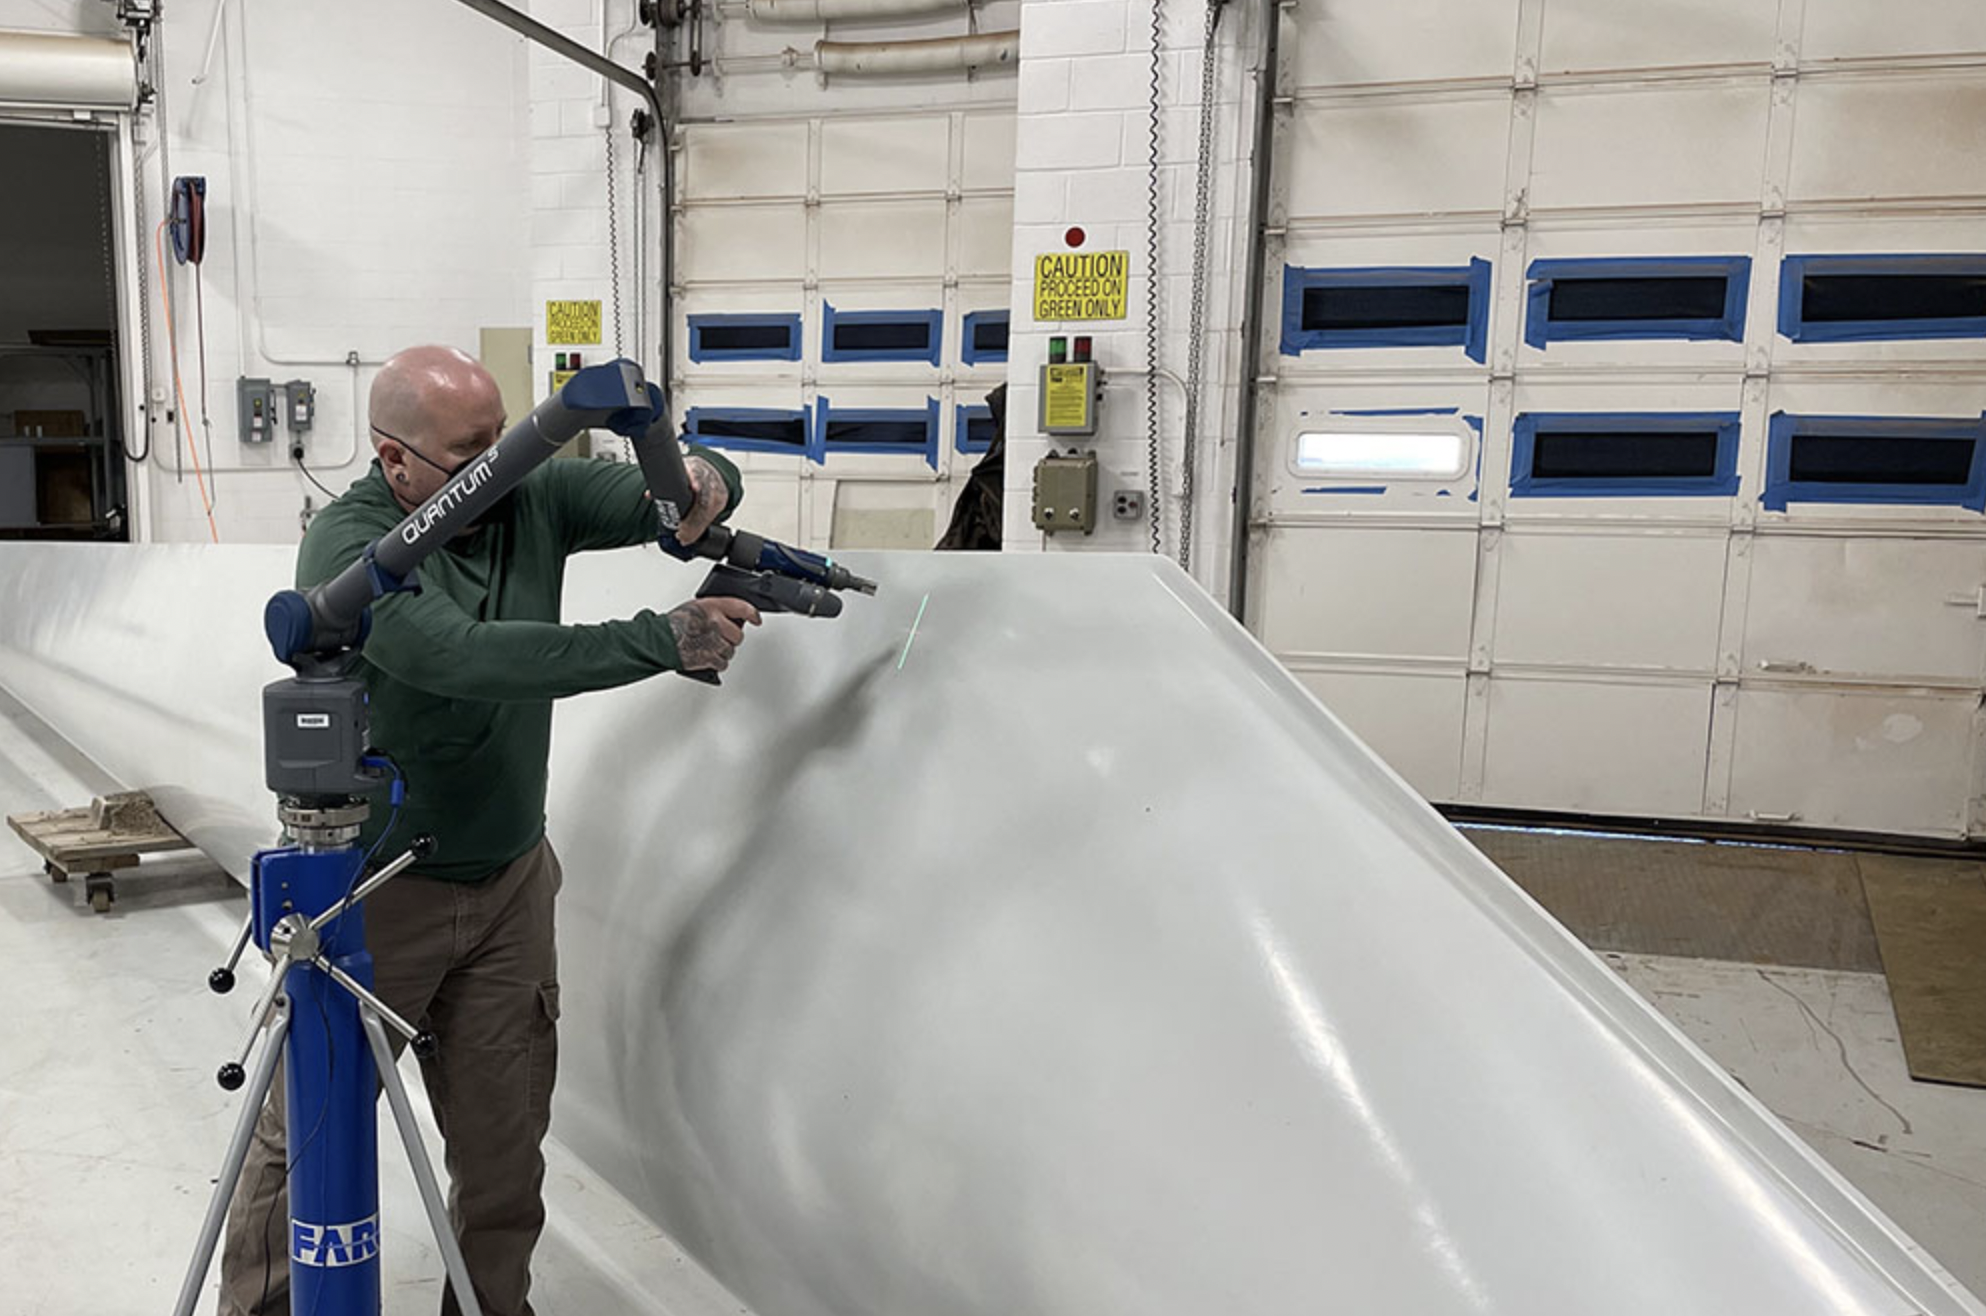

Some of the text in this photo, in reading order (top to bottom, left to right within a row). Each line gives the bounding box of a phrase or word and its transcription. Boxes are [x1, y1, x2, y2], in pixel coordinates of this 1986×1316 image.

[1041, 254, 1122, 278] CAUTION
[1040, 278, 1121, 297] PROCEED ON
[550, 301, 599, 317] CAUTION
[1040, 298, 1121, 318] GREEN ONLY
[401, 461, 493, 544] QUANTUM
[293, 1221, 379, 1263] FAR
